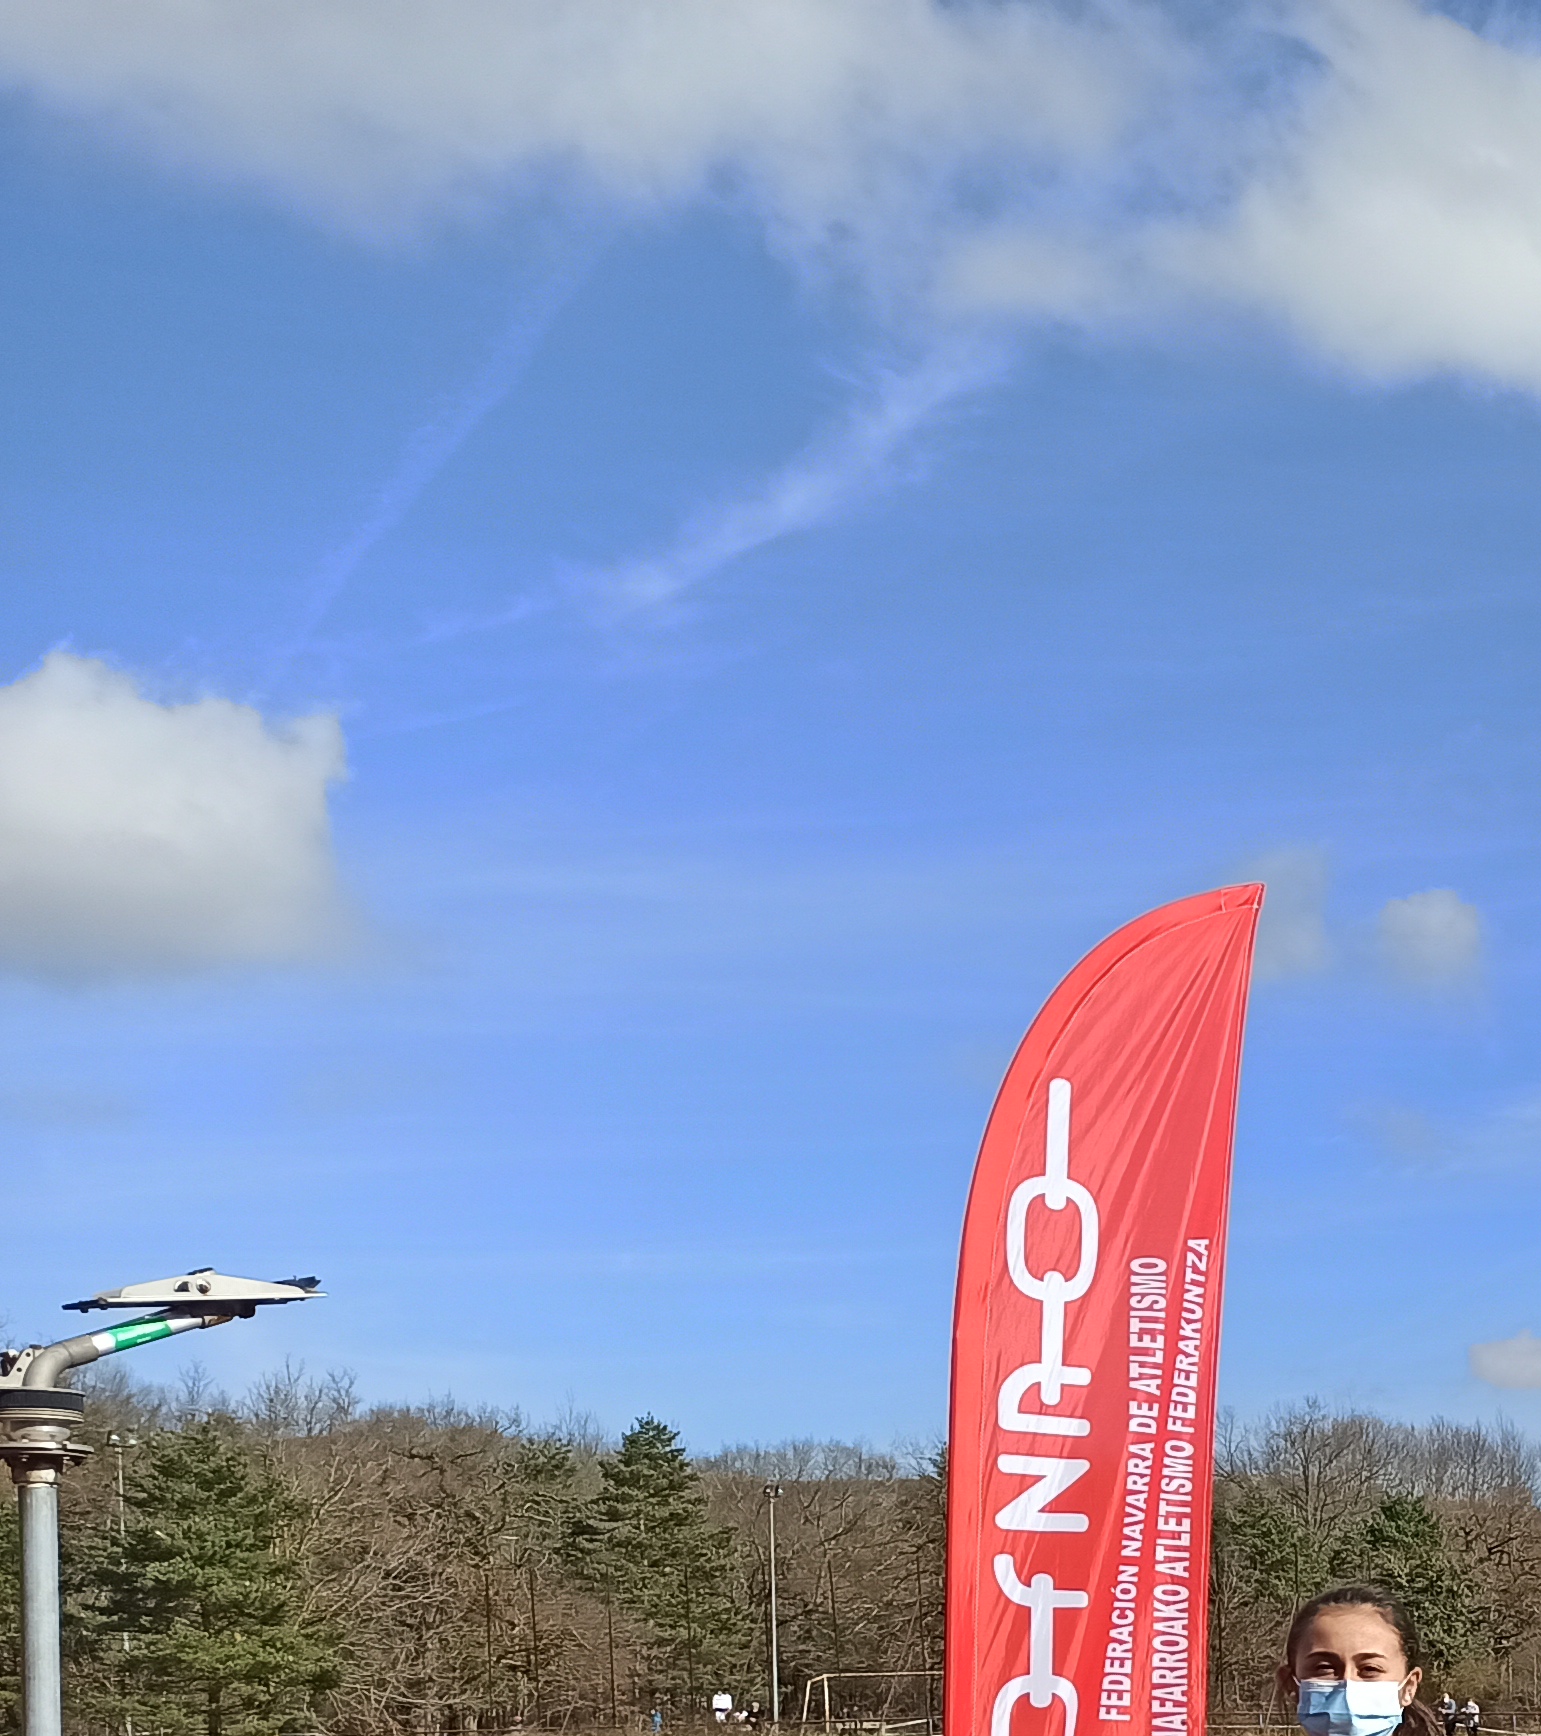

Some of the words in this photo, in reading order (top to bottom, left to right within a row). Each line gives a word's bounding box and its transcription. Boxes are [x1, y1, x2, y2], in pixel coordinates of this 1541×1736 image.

[1130, 1257, 1167, 1396] ATLETISMO
[1167, 1238, 1209, 1434] FEDERAKUNTZA
[1129, 1401, 1159, 1434] DE
[1121, 1442, 1154, 1557] NAVARRA
[1155, 1440, 1195, 1578] ATLETISMO
[1099, 1565, 1140, 1722] FEDERACIÓN
